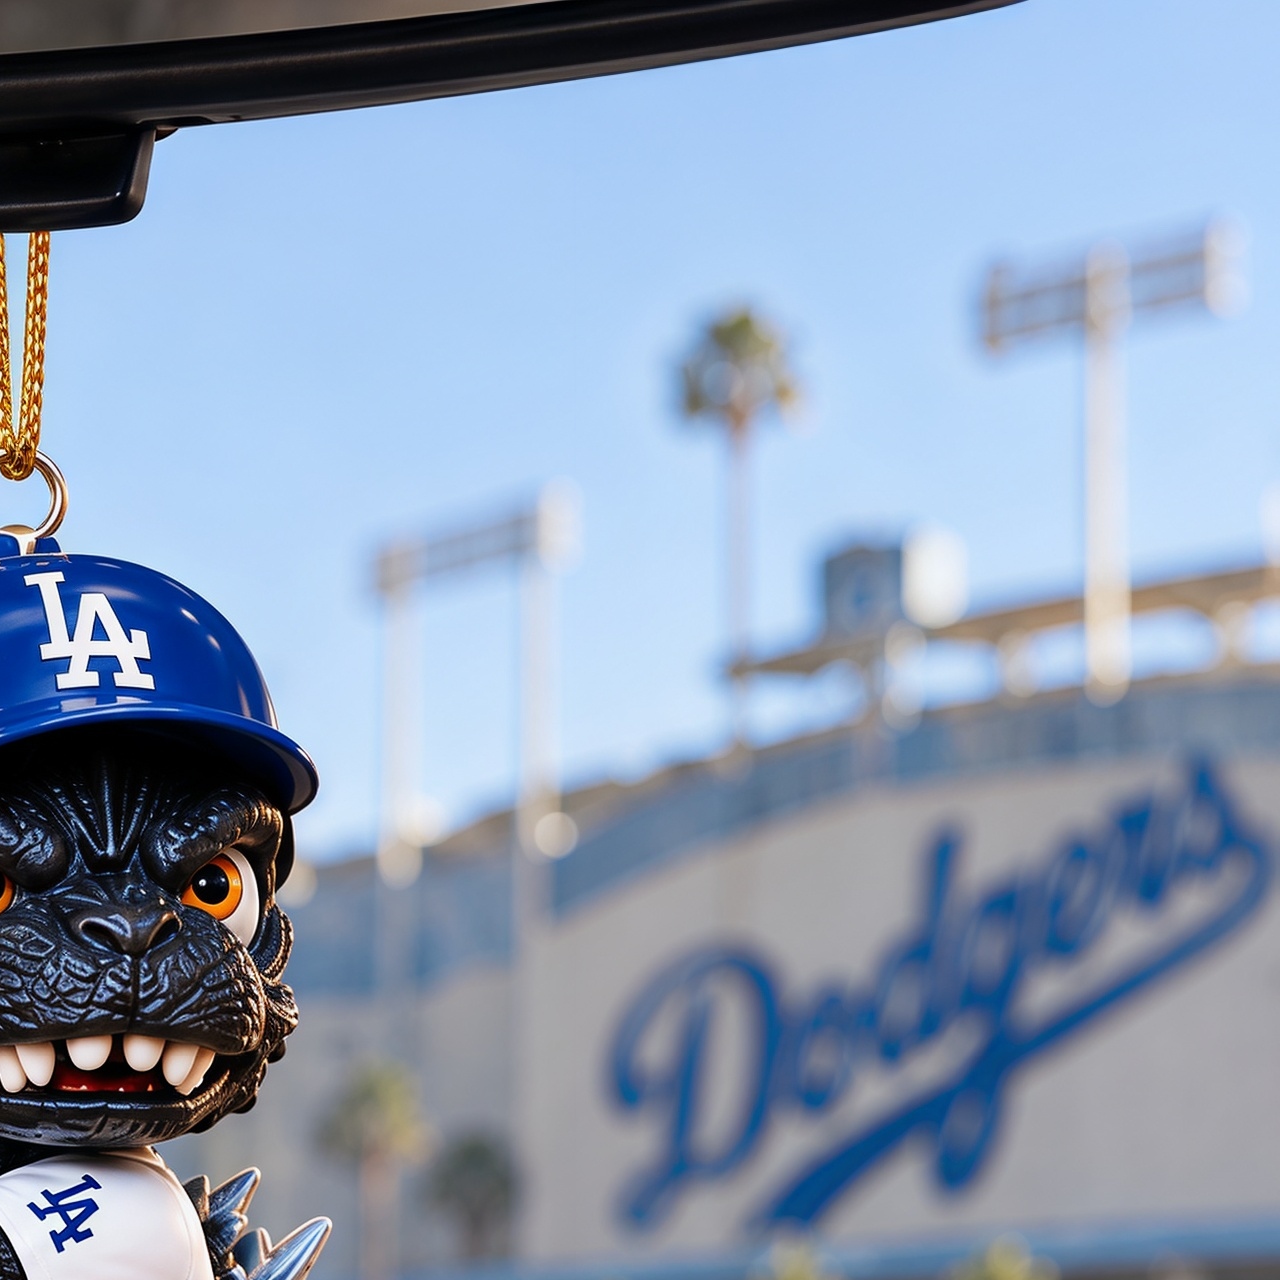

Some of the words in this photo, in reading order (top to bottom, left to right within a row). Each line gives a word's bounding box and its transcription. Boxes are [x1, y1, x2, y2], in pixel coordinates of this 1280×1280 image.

[23, 571, 155, 690] LA
[606, 750, 1272, 1232] Dodgers
[27, 1174, 102, 1253] LA
